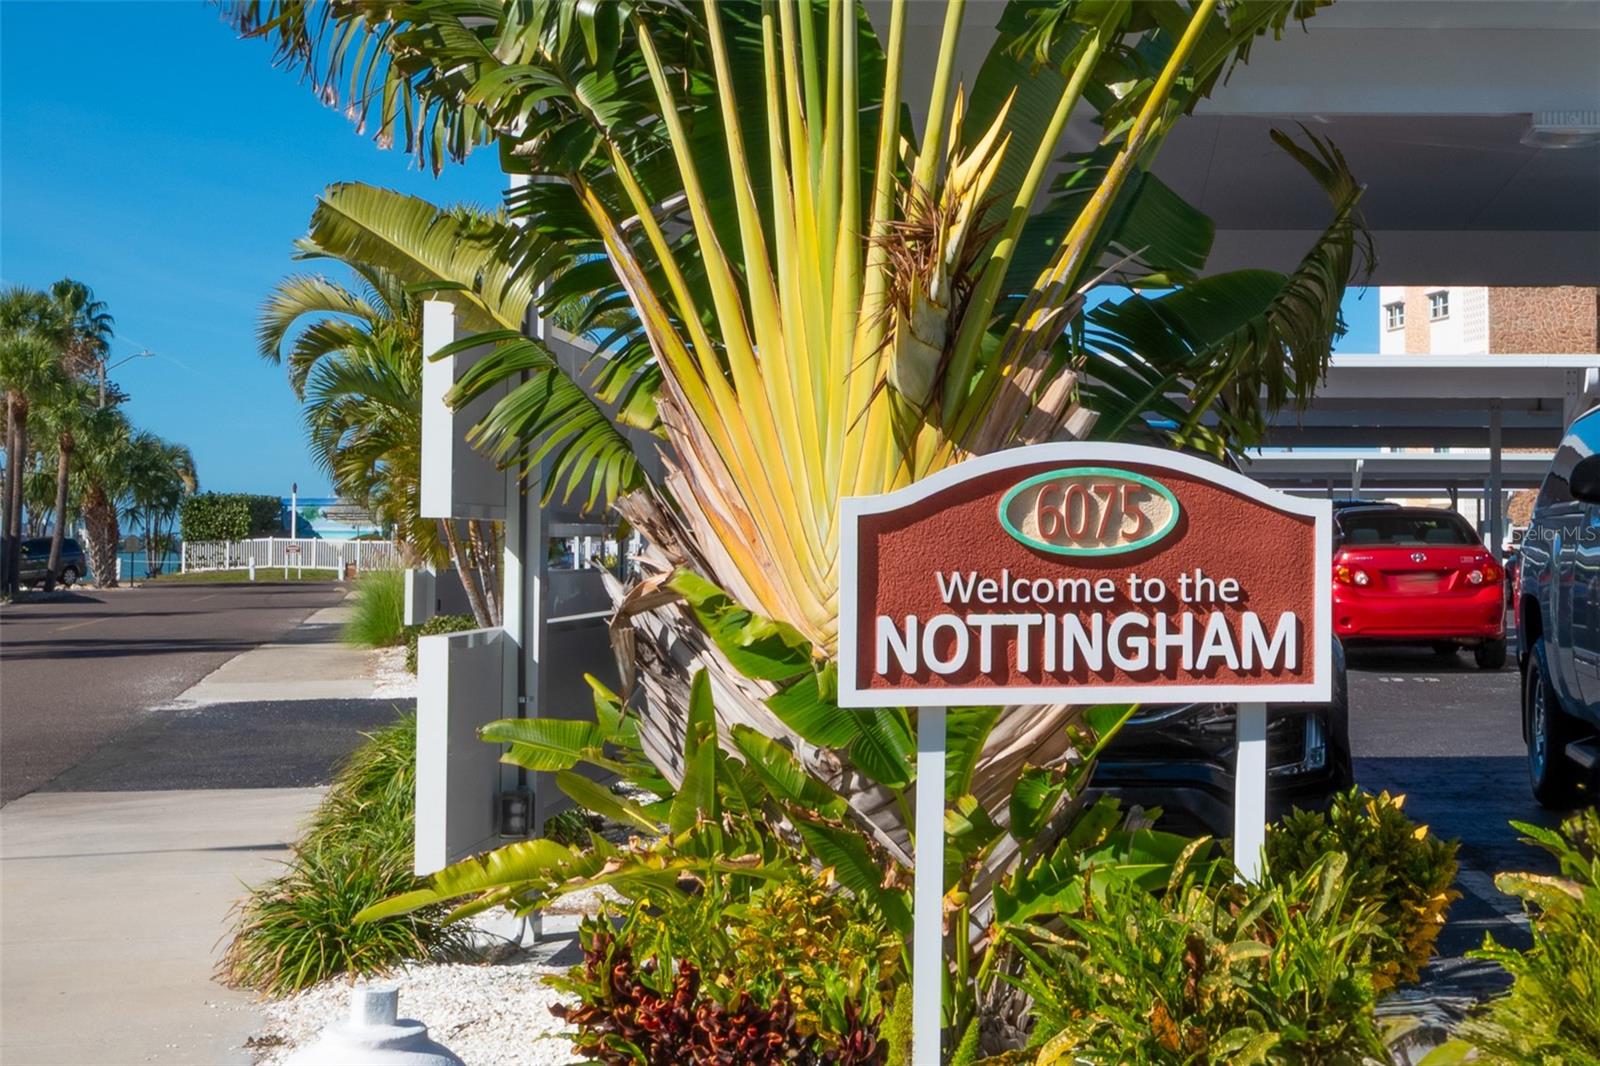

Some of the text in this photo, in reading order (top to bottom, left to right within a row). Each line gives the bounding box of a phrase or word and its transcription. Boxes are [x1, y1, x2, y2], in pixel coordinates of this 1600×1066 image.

[1034, 484, 1146, 541] 6075
[936, 568, 1240, 604] Welcome to the
[875, 611, 1297, 675] NOTTINGHAM
